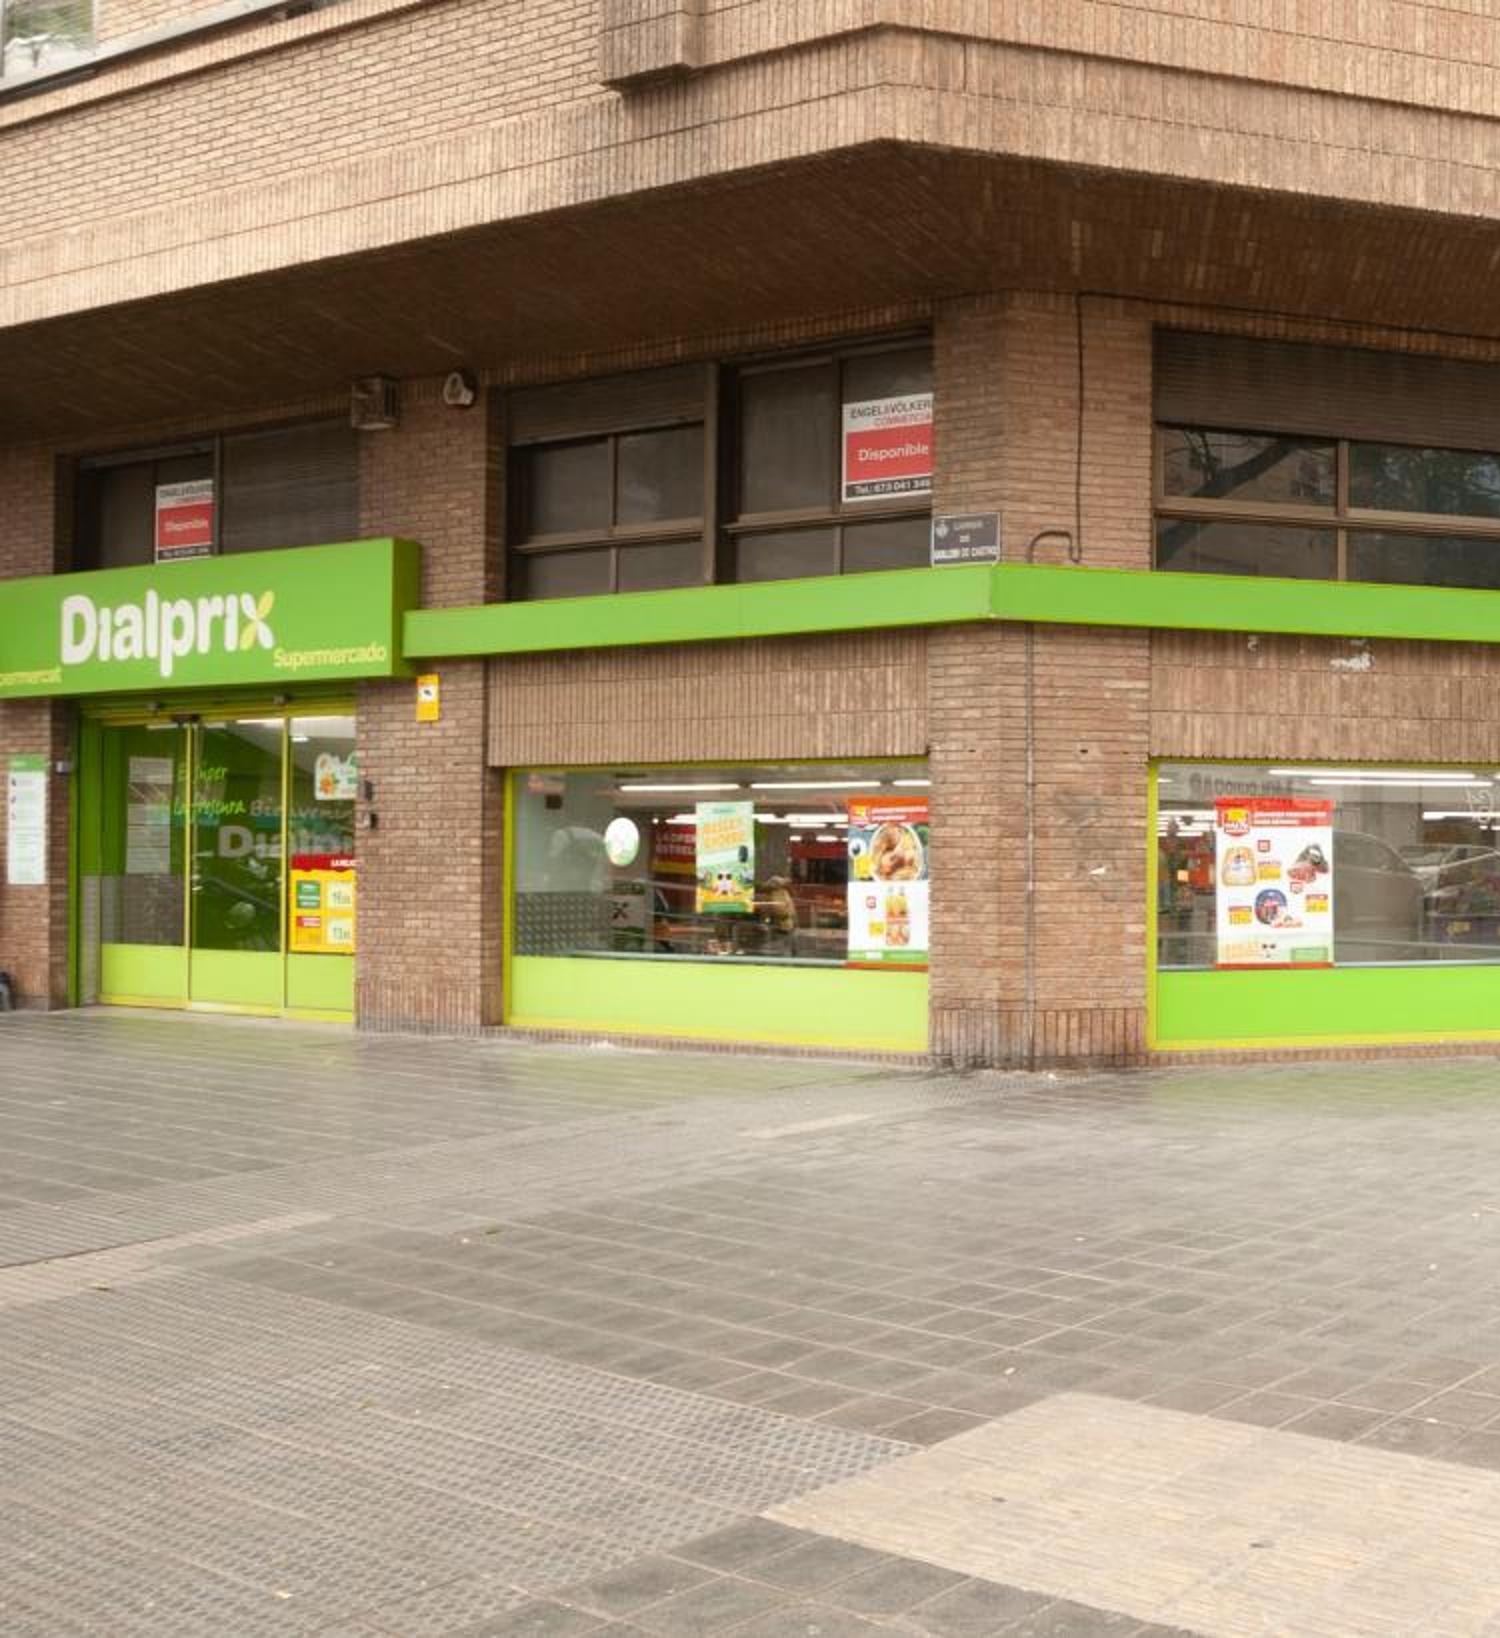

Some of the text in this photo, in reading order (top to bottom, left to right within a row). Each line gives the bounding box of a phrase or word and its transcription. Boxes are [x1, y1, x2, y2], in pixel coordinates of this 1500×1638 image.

[858, 443, 929, 461] Disponible
[61, 588, 276, 678] Dialprix
[273, 641, 386, 672] Supermercado
